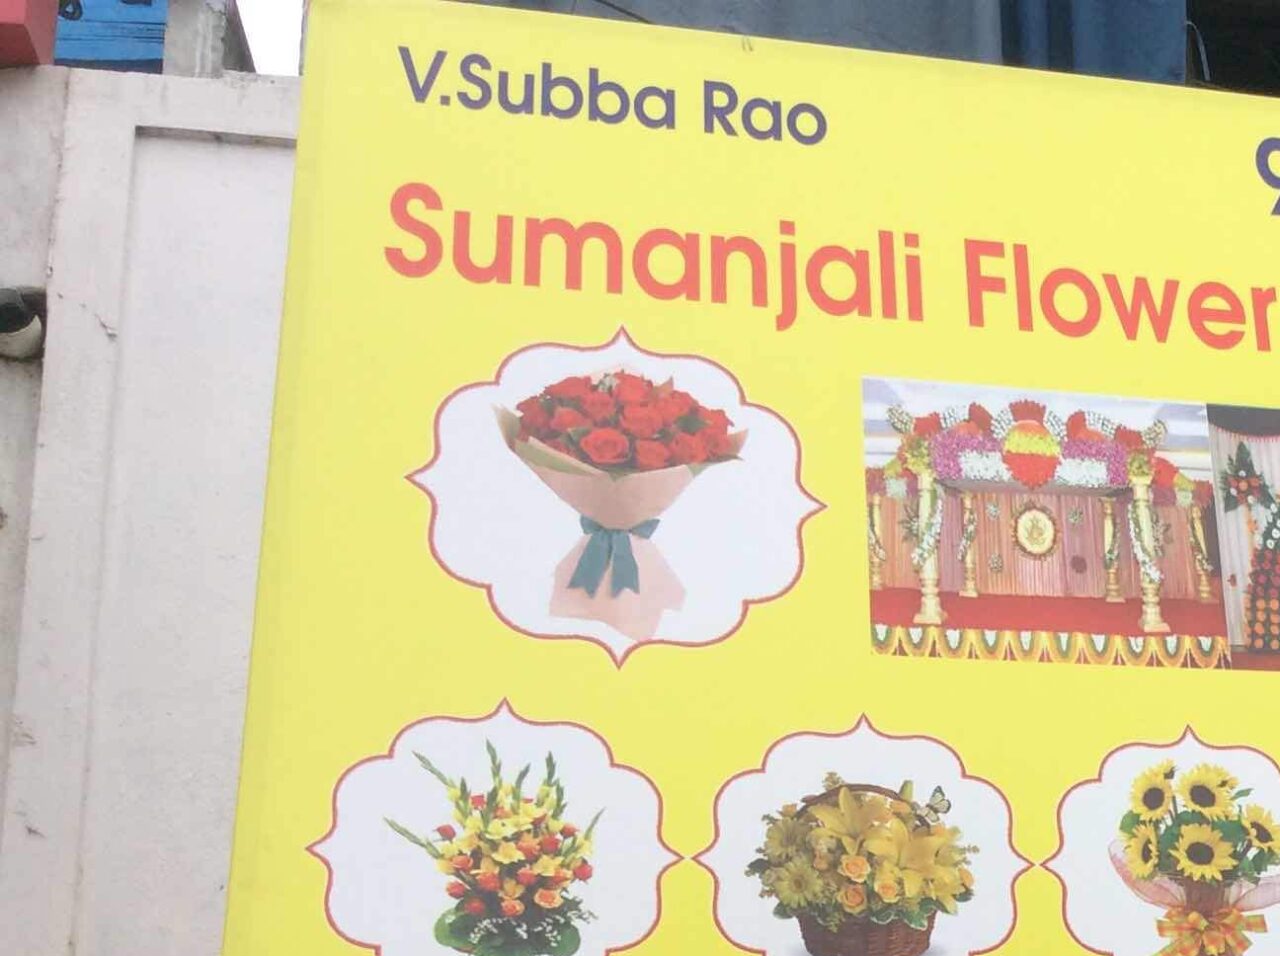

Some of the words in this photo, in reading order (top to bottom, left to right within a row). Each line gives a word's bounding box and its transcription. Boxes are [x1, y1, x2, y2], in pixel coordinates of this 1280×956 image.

[399, 45, 676, 131] V.Subba
[703, 79, 829, 147] Rao
[384, 182, 924, 332] Sumanjali
[964, 238, 1278, 352] Flower
